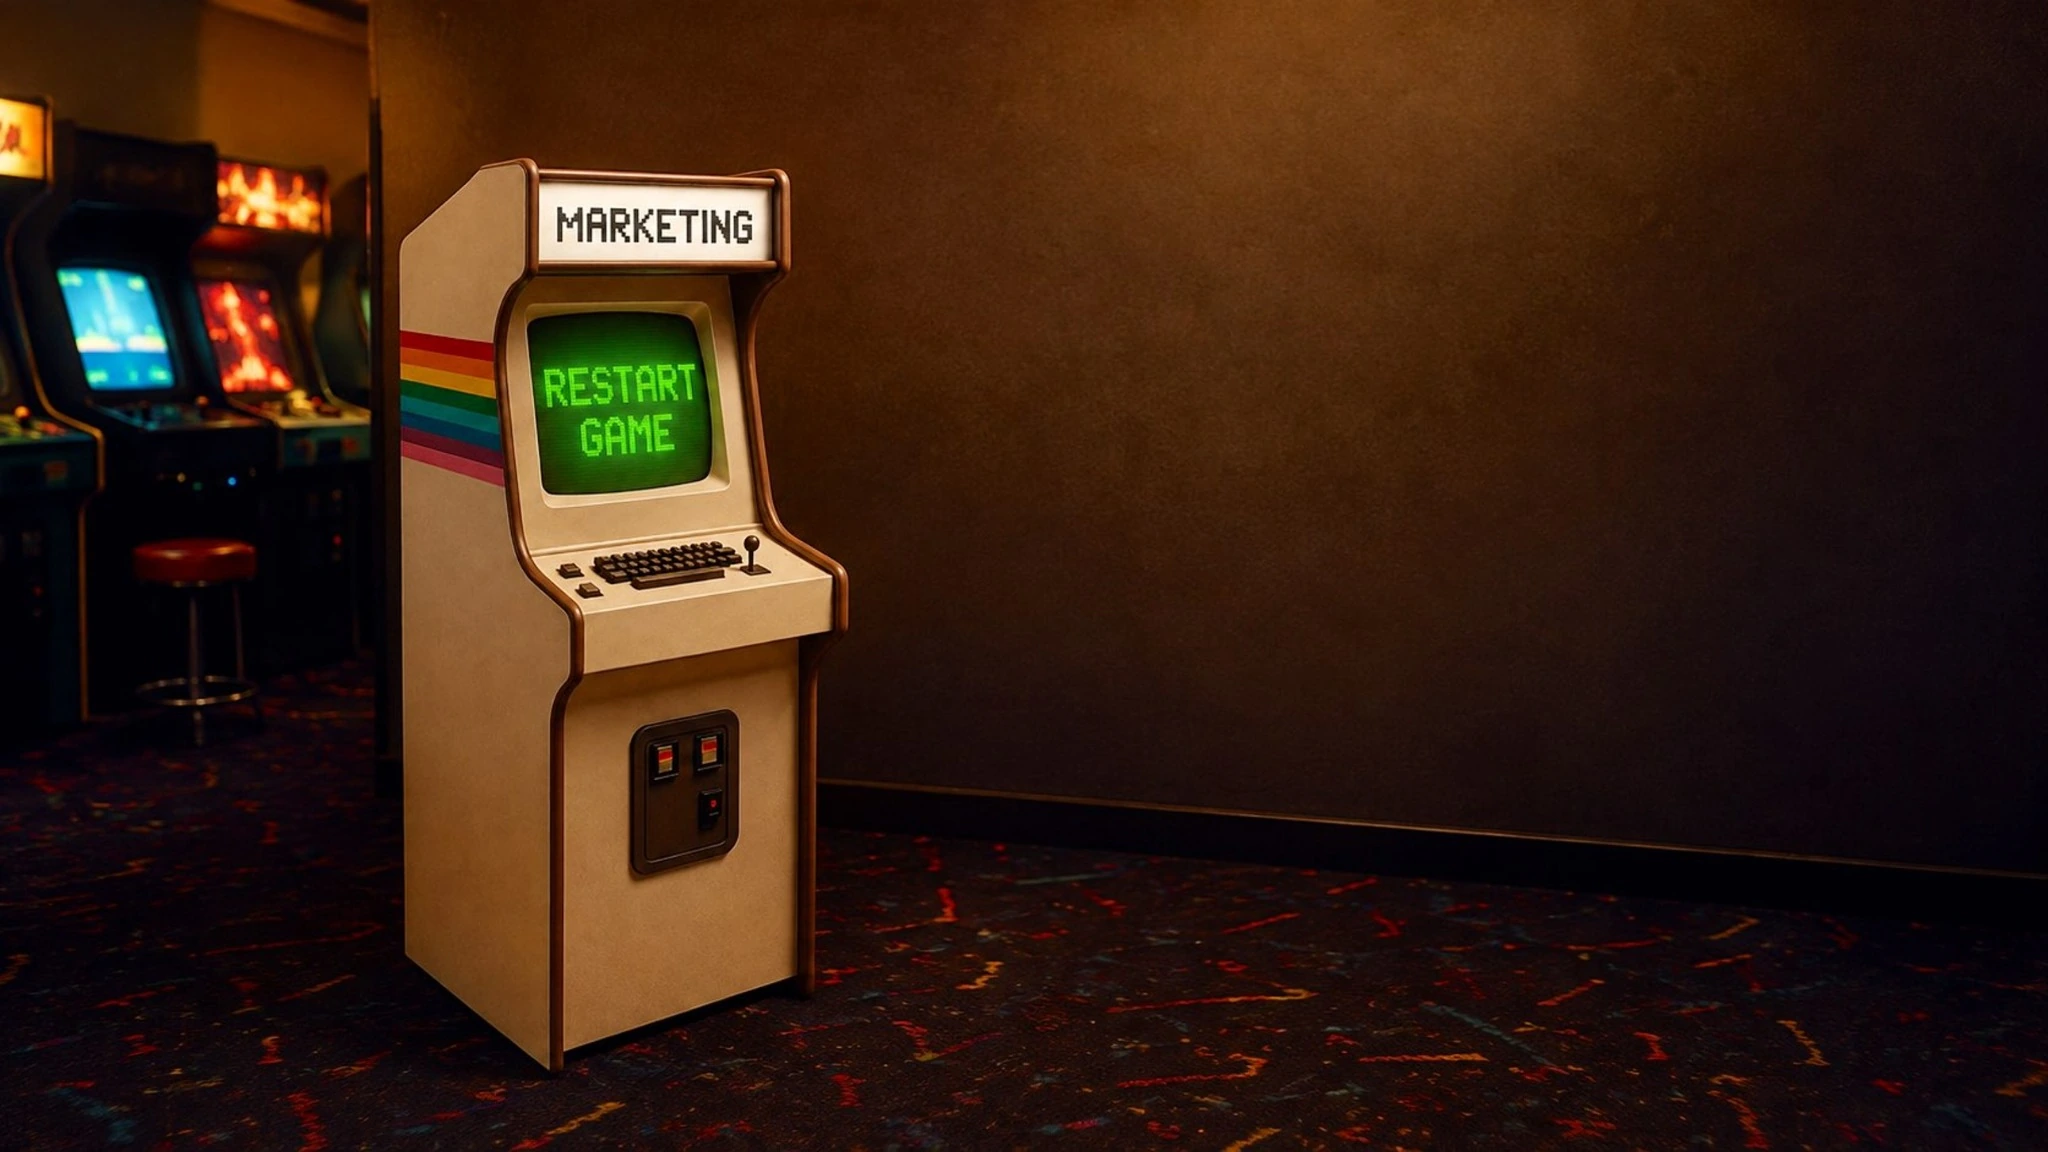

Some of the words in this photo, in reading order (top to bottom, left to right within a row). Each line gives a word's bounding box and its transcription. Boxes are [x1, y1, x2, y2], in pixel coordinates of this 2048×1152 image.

[557, 207, 752, 243] MARKETING
[543, 364, 695, 407] RESTART
[580, 413, 675, 456] GAME
